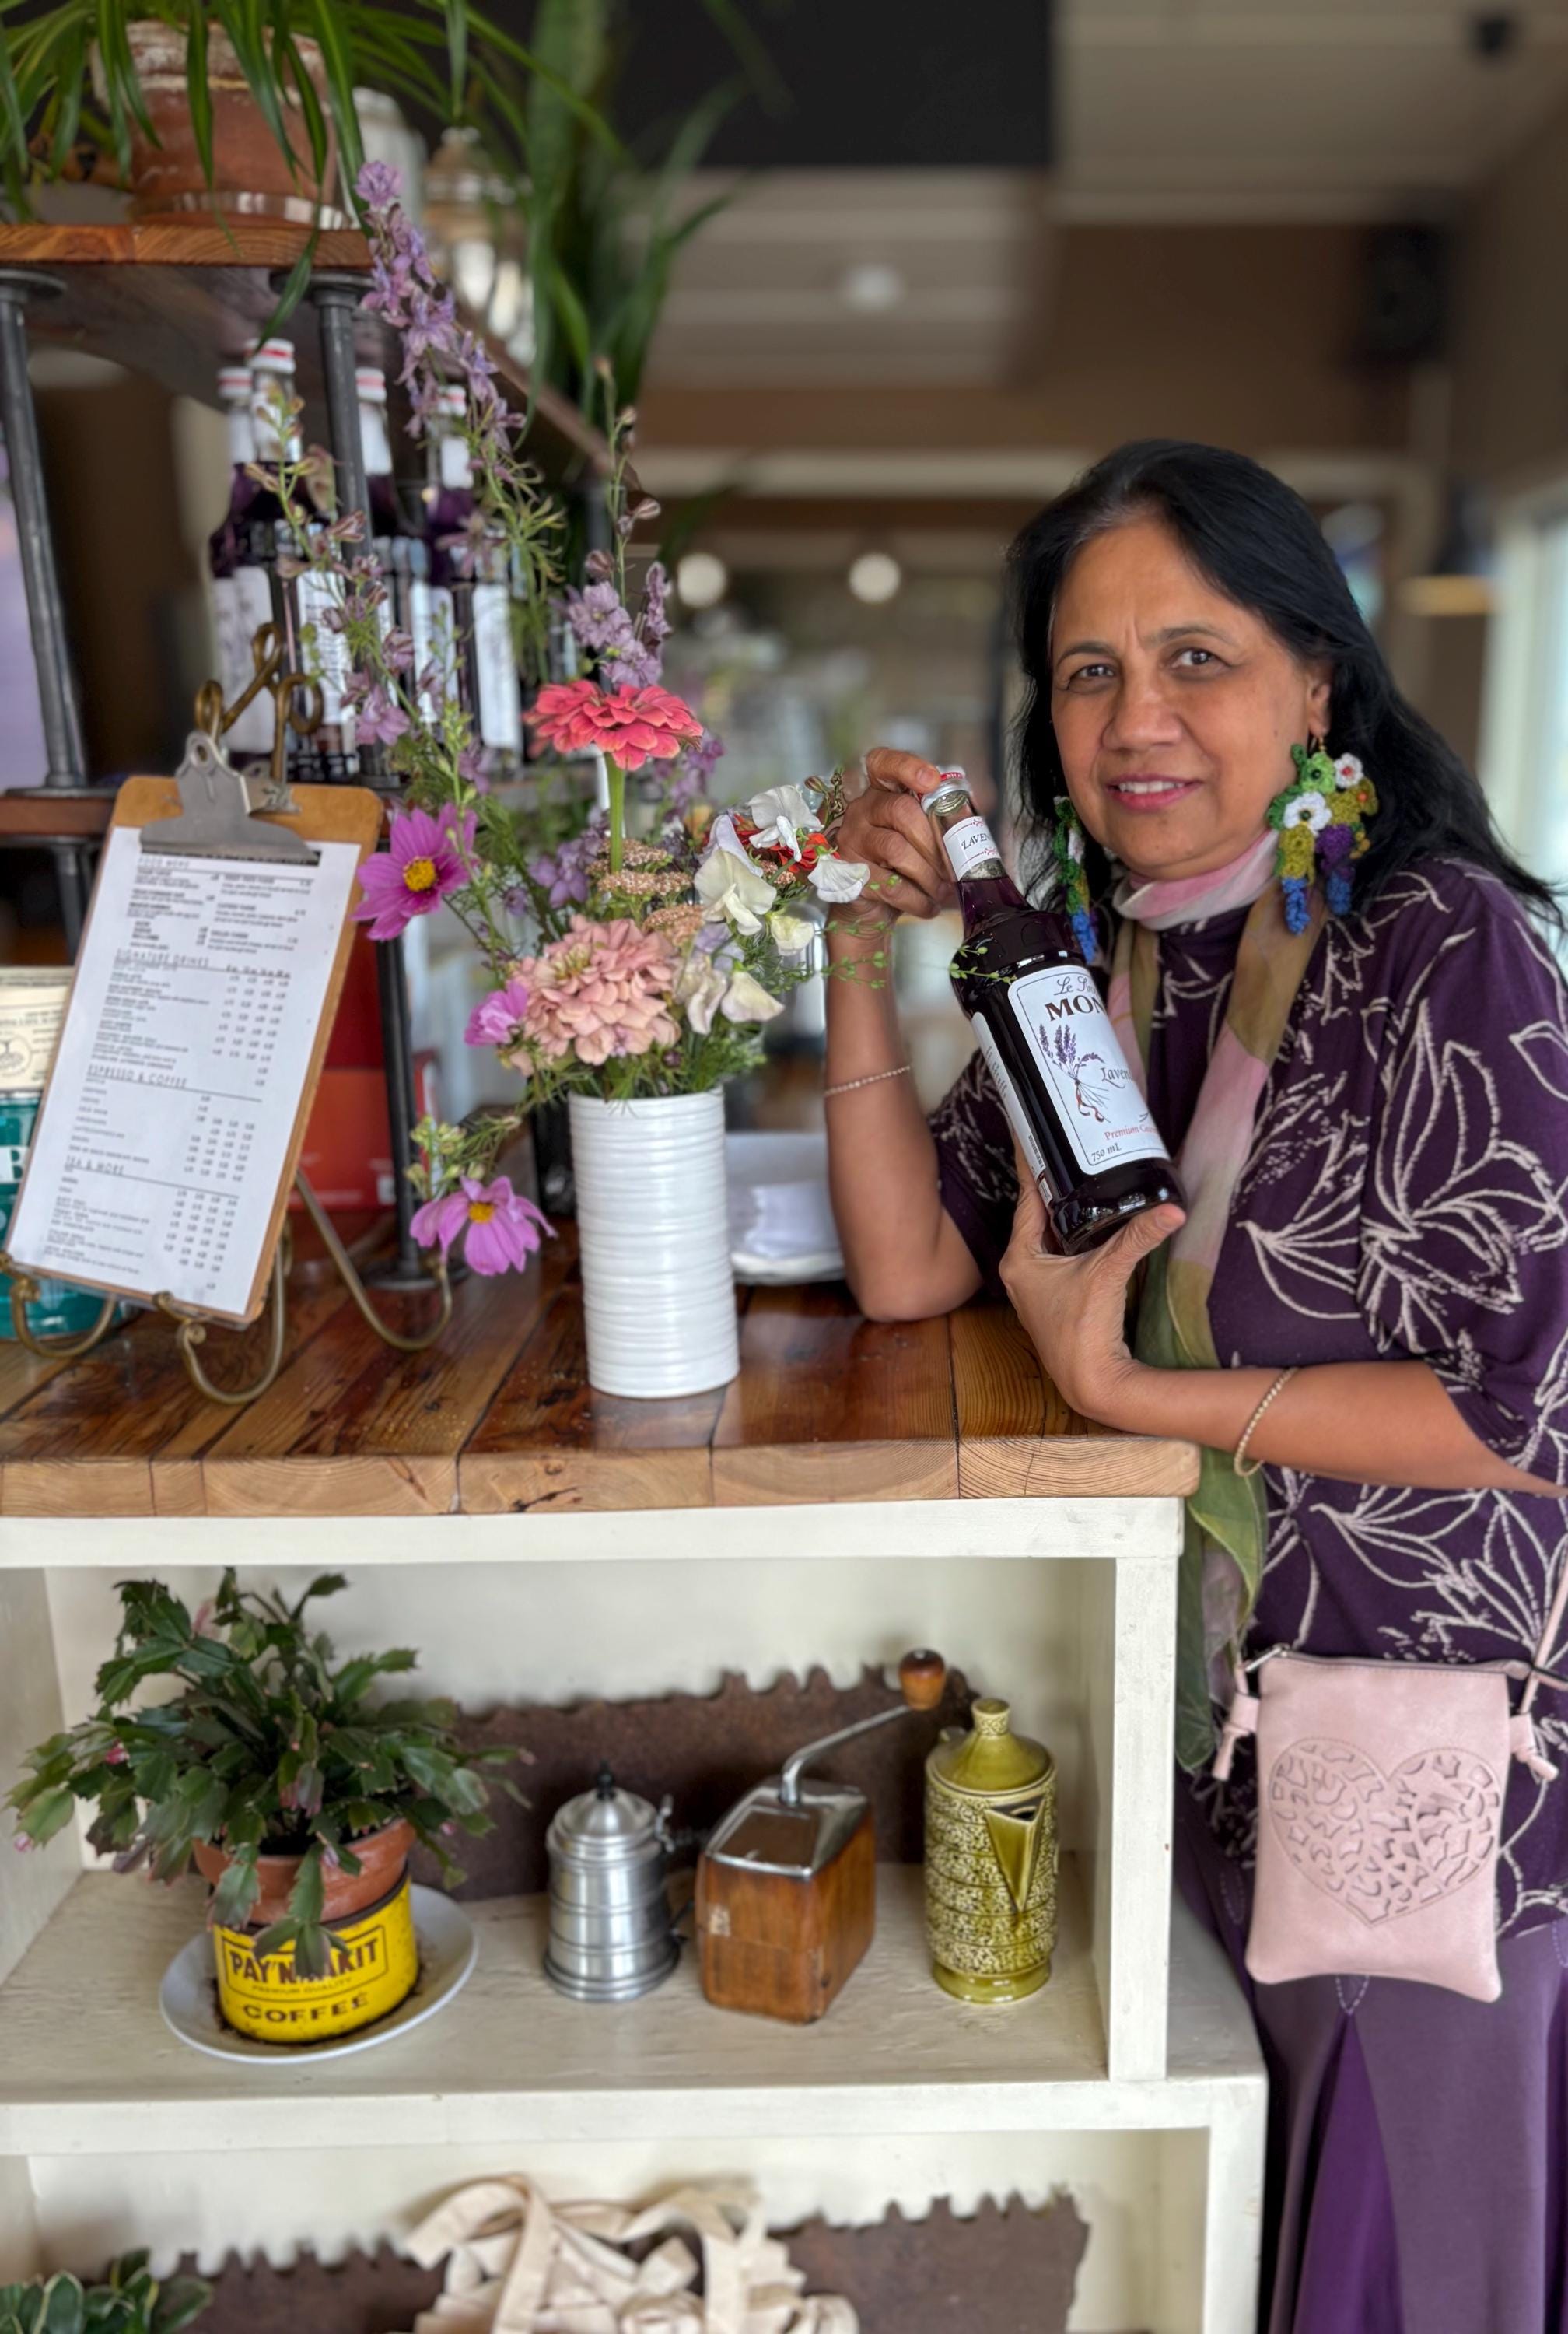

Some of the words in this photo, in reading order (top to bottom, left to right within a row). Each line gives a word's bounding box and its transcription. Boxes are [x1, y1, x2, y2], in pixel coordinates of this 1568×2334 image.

[1053, 976, 1074, 996] Le
[87, 1064, 135, 1082] ESPRESSO
[148, 1073, 187, 1089] COFFEE
[1104, 1124, 1139, 1141] Premium
[1090, 1150, 1105, 1162] 750
[96, 1160, 125, 1176] MORE
[242, 1992, 369, 2023] COFFEE
